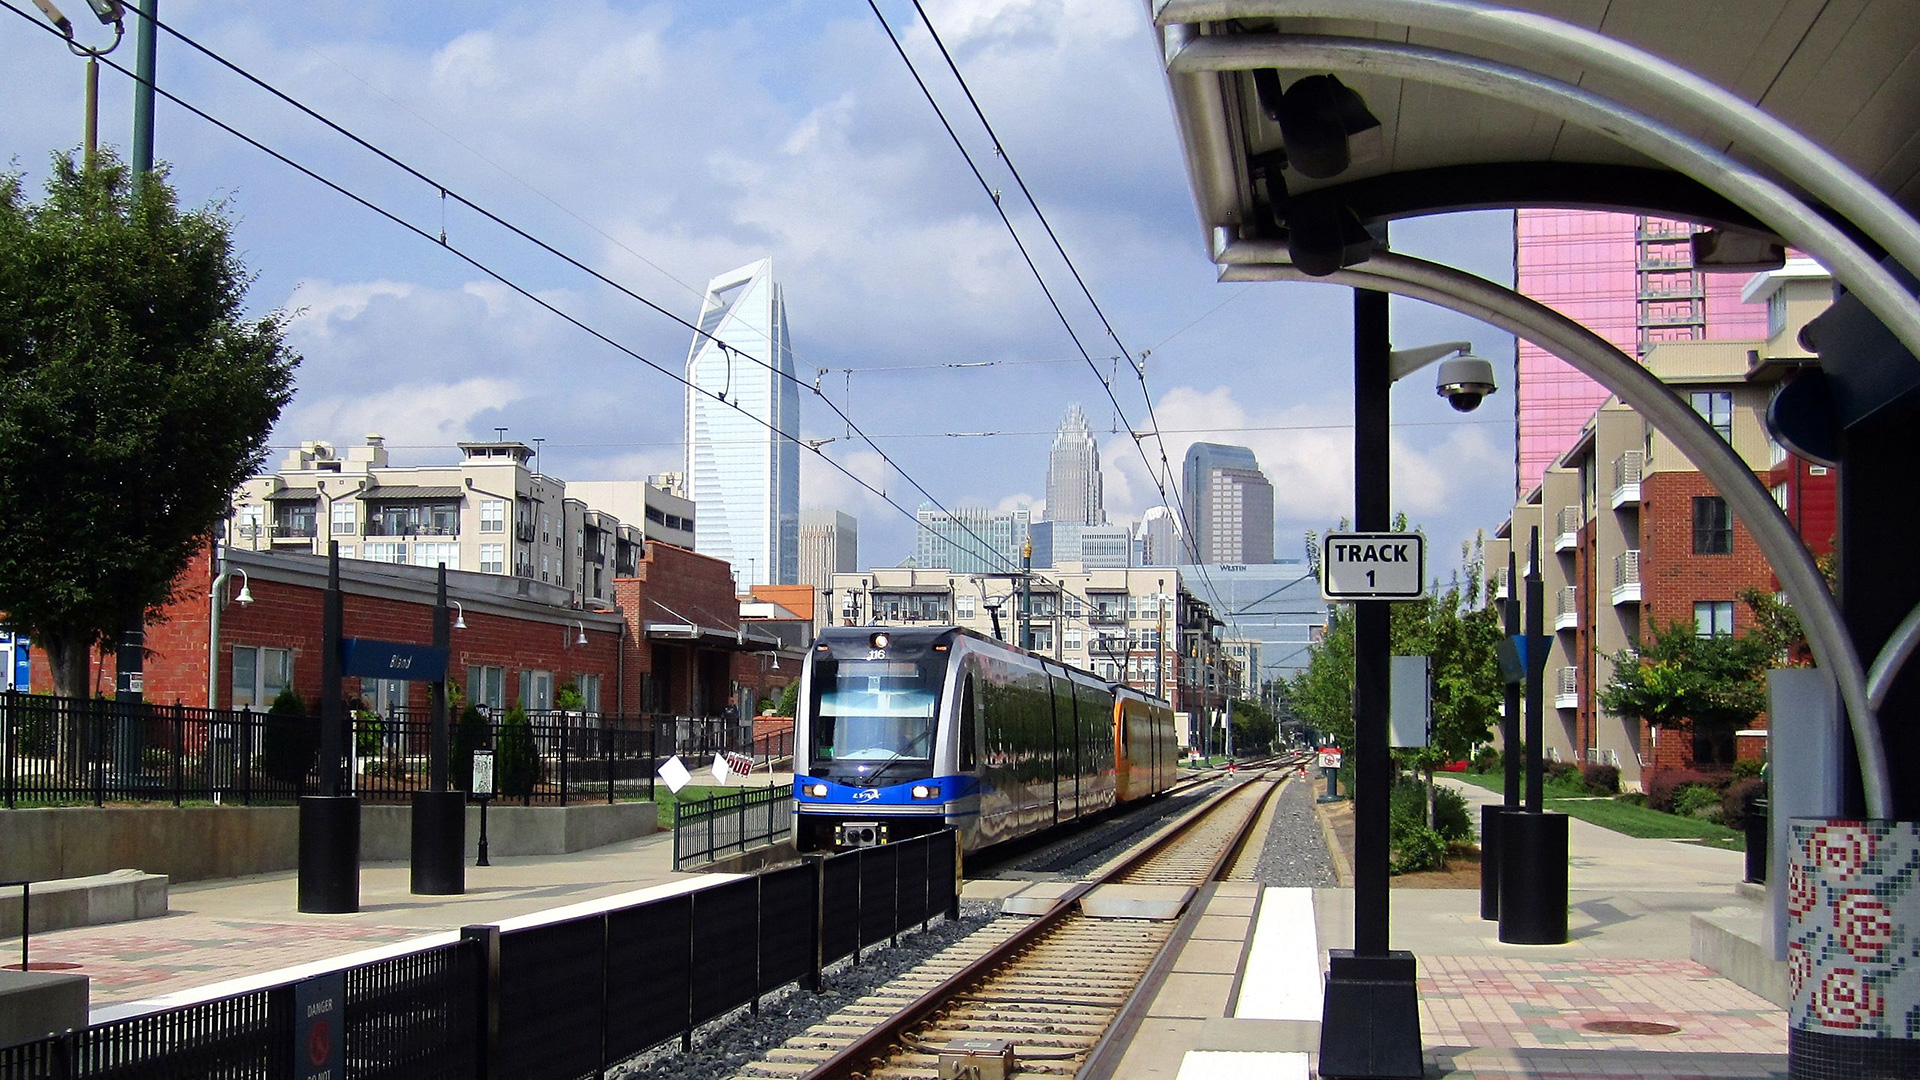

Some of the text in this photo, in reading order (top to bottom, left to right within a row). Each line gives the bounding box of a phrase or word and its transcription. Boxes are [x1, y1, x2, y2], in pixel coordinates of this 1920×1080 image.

[1335, 545, 1408, 562] TRACK
[1366, 570, 1375, 587] 1
[390, 655, 412, 669] Bland
[869, 650, 886, 660] 116
[307, 999, 333, 1017] DANGER
